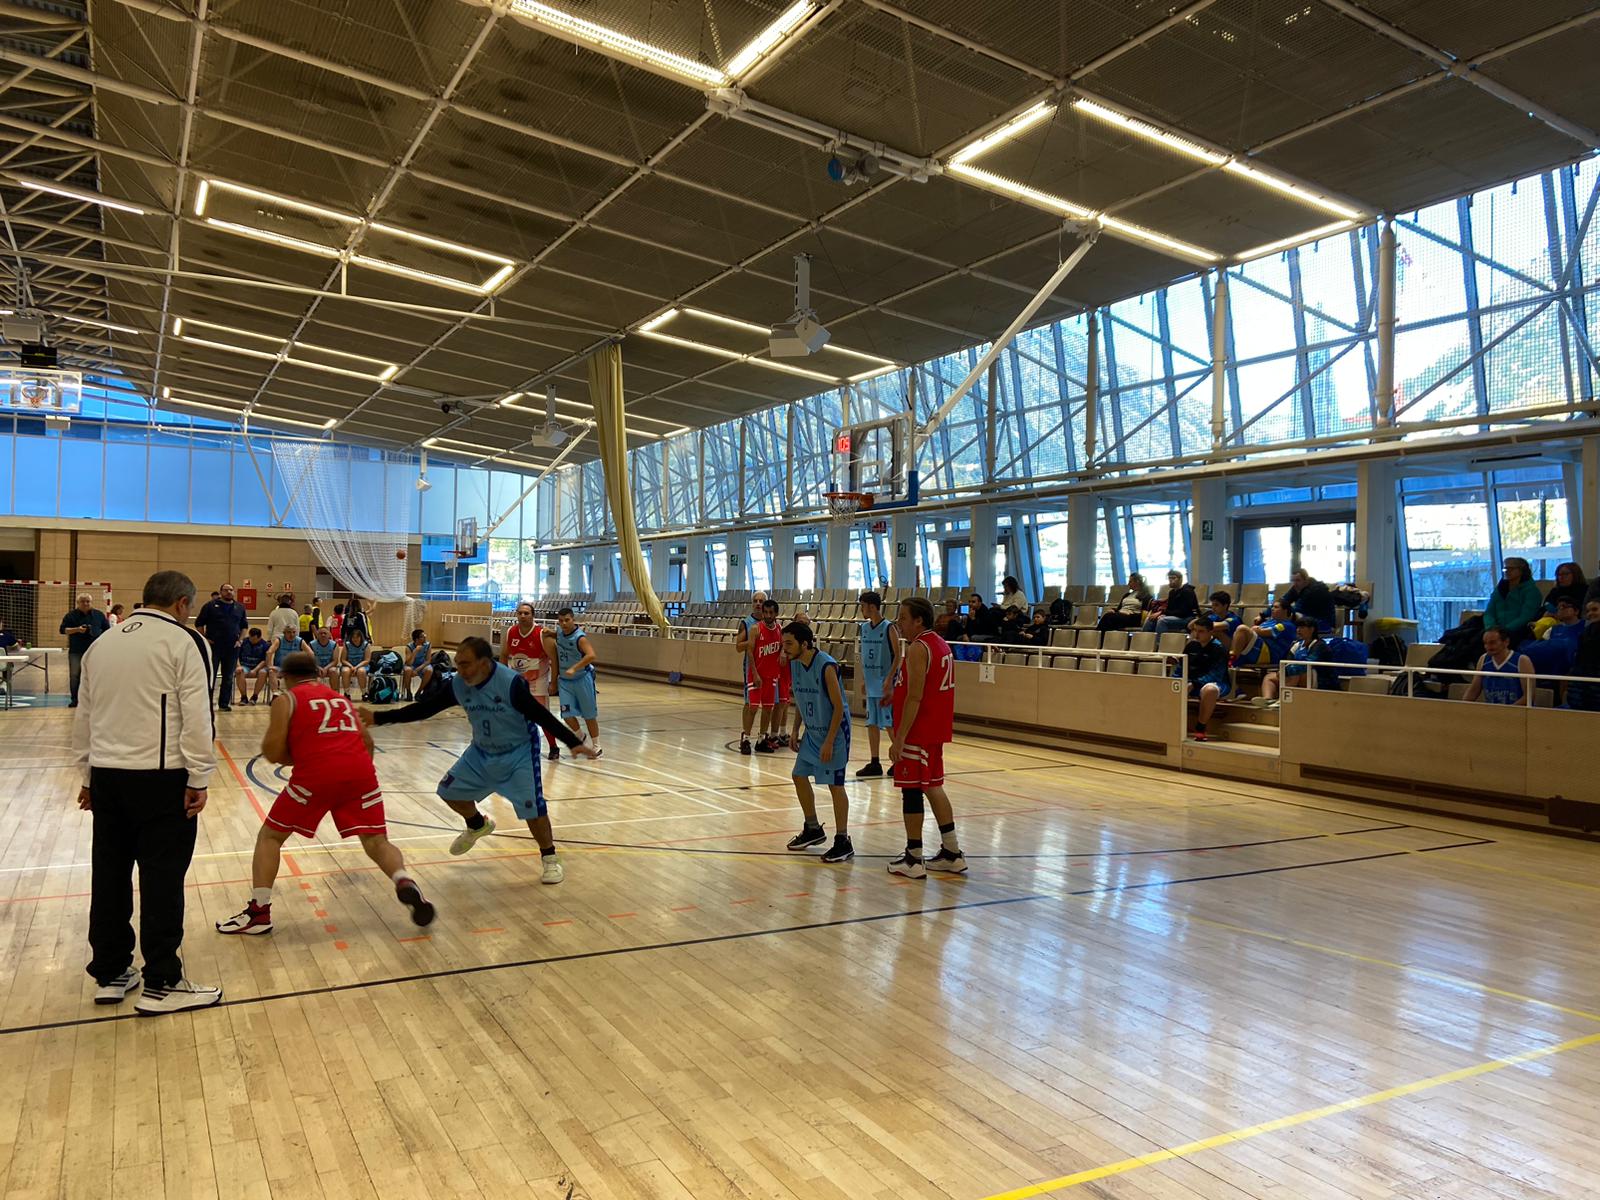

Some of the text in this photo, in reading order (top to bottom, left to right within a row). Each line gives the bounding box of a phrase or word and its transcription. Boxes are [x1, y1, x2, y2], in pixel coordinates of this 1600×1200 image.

[758, 641, 780, 658] PINED
[868, 648, 874, 659] 5
[1172, 682, 1179, 692] G
[1284, 691, 1291, 701] F
[308, 698, 358, 733] 23
[805, 702, 814, 717] 13
[482, 720, 491, 737] 9
